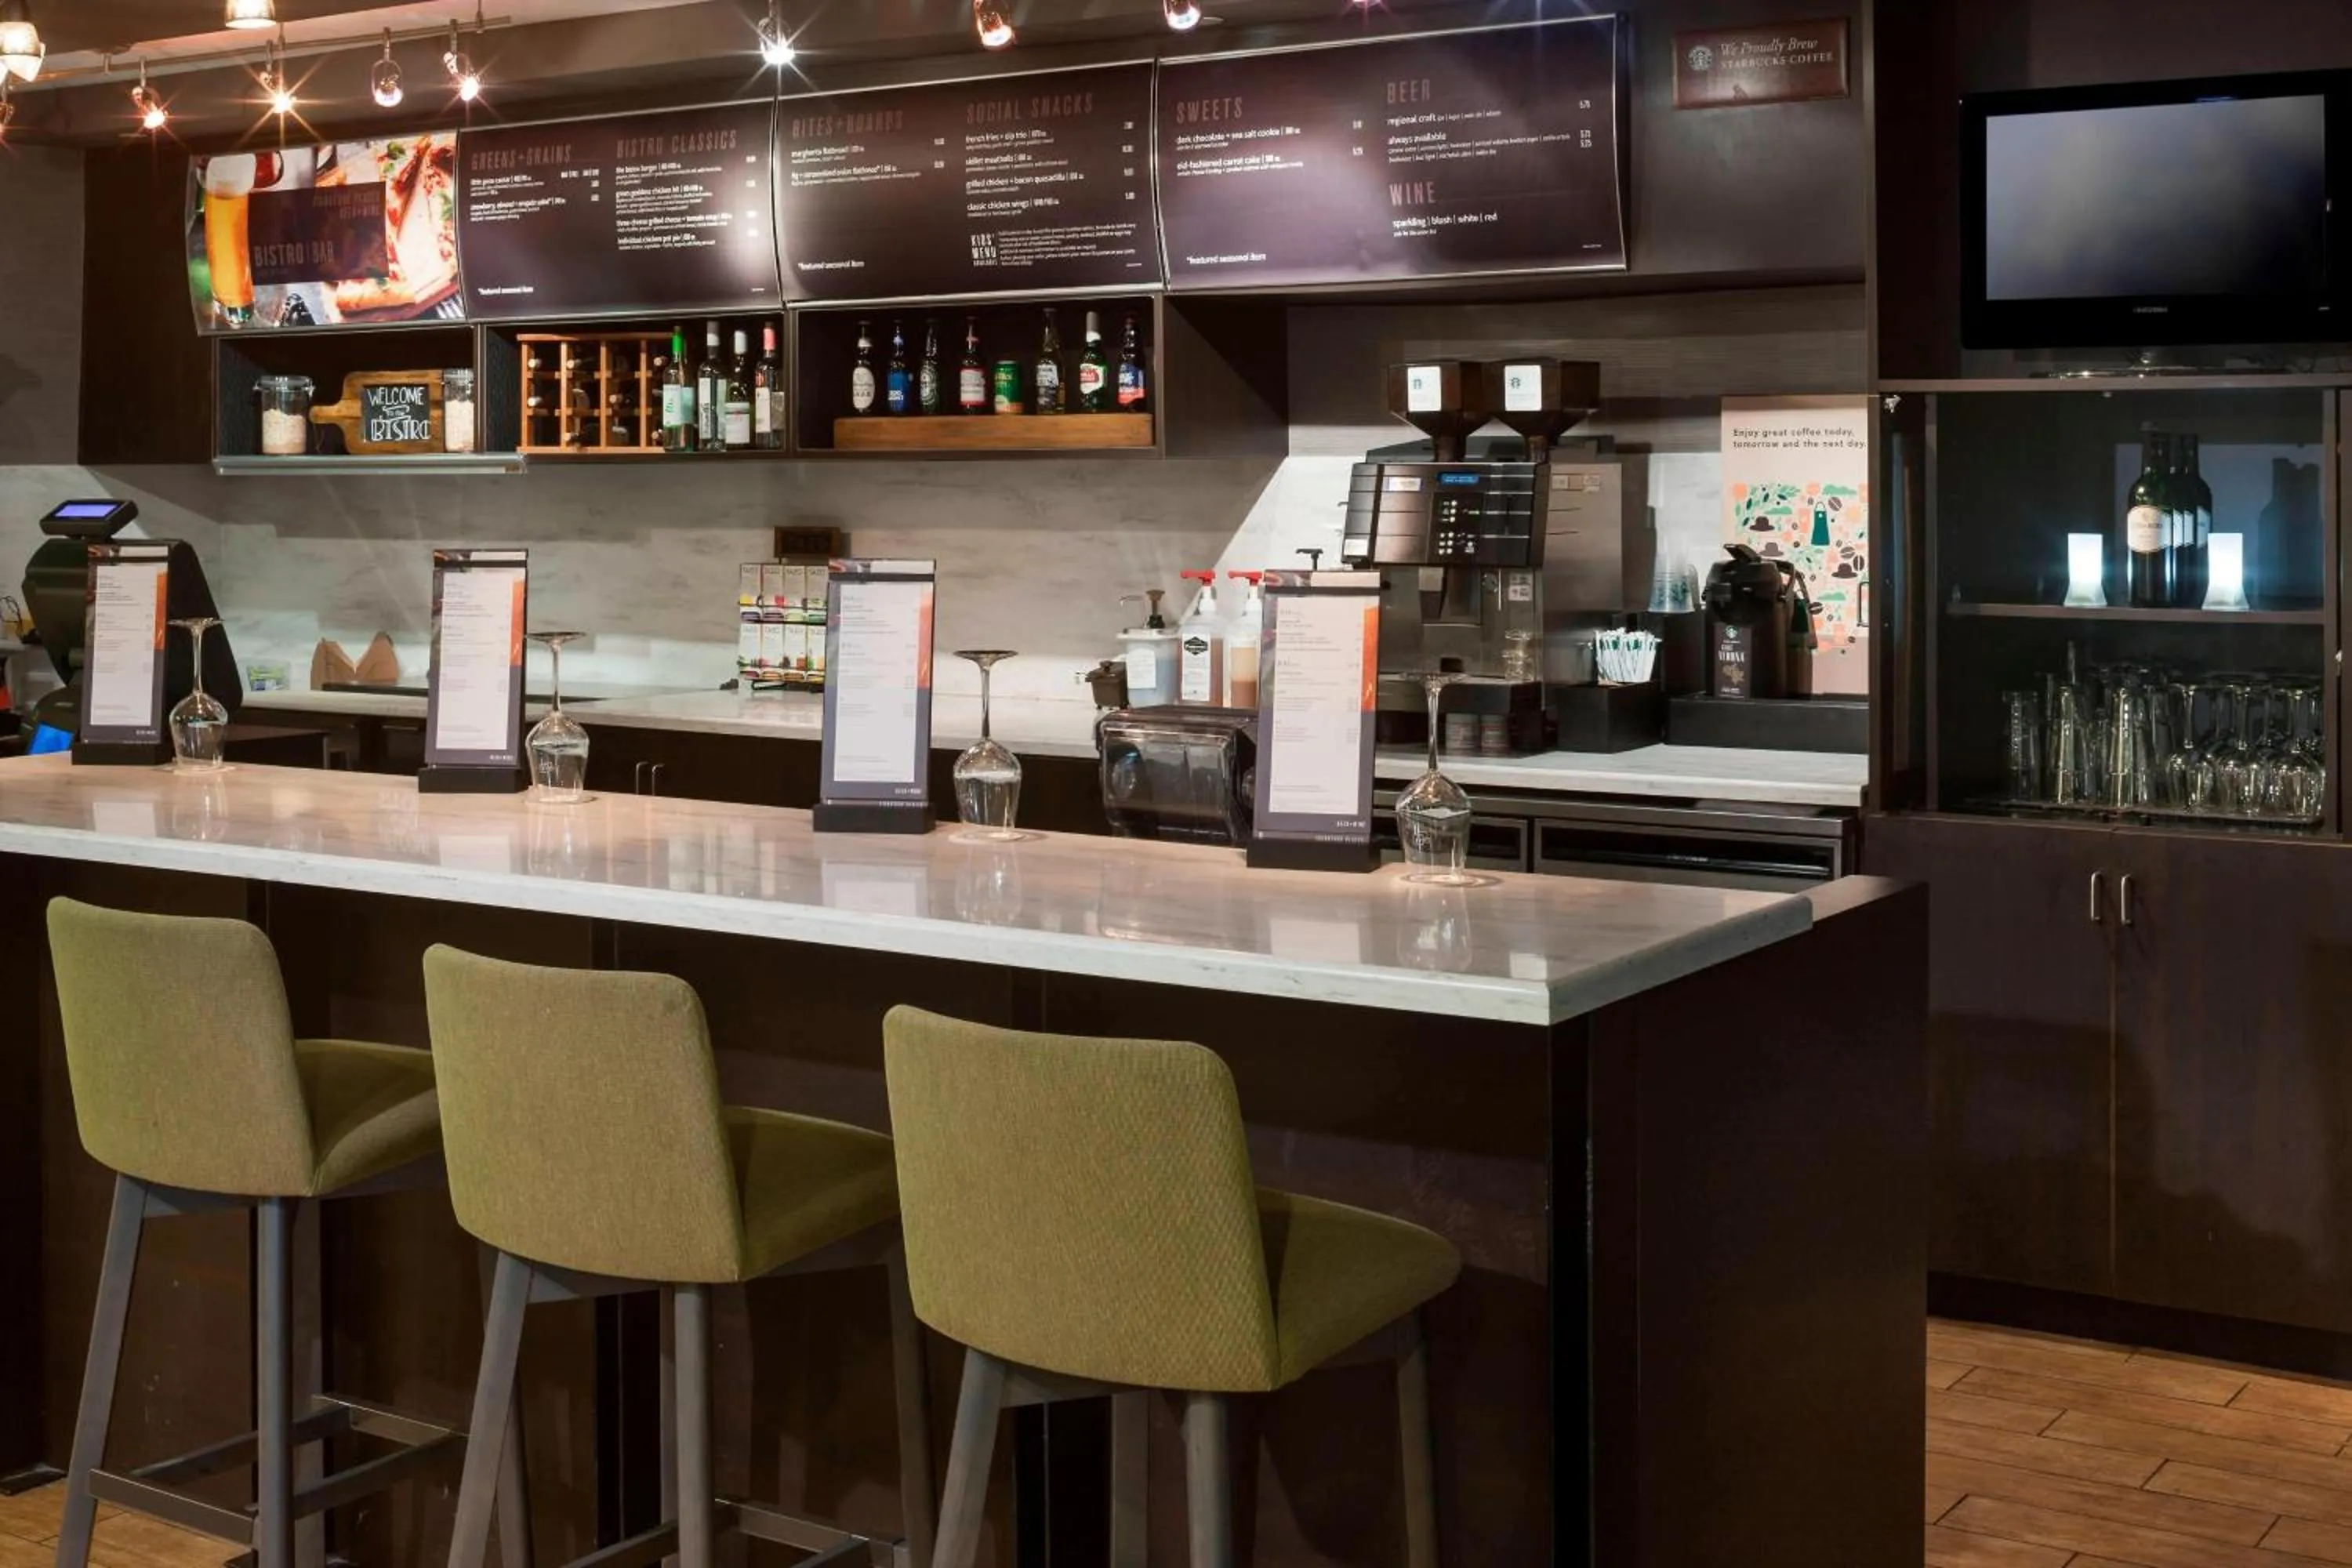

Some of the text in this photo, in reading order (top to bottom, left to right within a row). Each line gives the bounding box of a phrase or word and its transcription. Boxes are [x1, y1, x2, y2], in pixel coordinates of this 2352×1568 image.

[1721, 38, 1818, 56] We Proudly Brew
[1721, 52, 1833, 69] STARBUCKS COFFEE
[1387, 79, 1430, 103] BEER
[967, 93, 1093, 123] SOCIAL SNACKS
[1177, 96, 1243, 124] SWEETS
[792, 117, 833, 139] BITES
[616, 129, 737, 158] BISTRO CLASSICS
[471, 150, 516, 171] GREENS
[526, 144, 572, 166] GRAINS
[1389, 181, 1436, 206] WINE
[1392, 216, 1426, 229] sparkling
[1457, 213, 1479, 223] white
[1484, 212, 1497, 222] red
[254, 241, 304, 267] BISTRO
[367, 387, 425, 407] WELCOME
[371, 419, 431, 441] BISTRO
[1733, 429, 1759, 437] Enjoy
[1762, 429, 1787, 438] great
[1791, 427, 1821, 437] coffee
